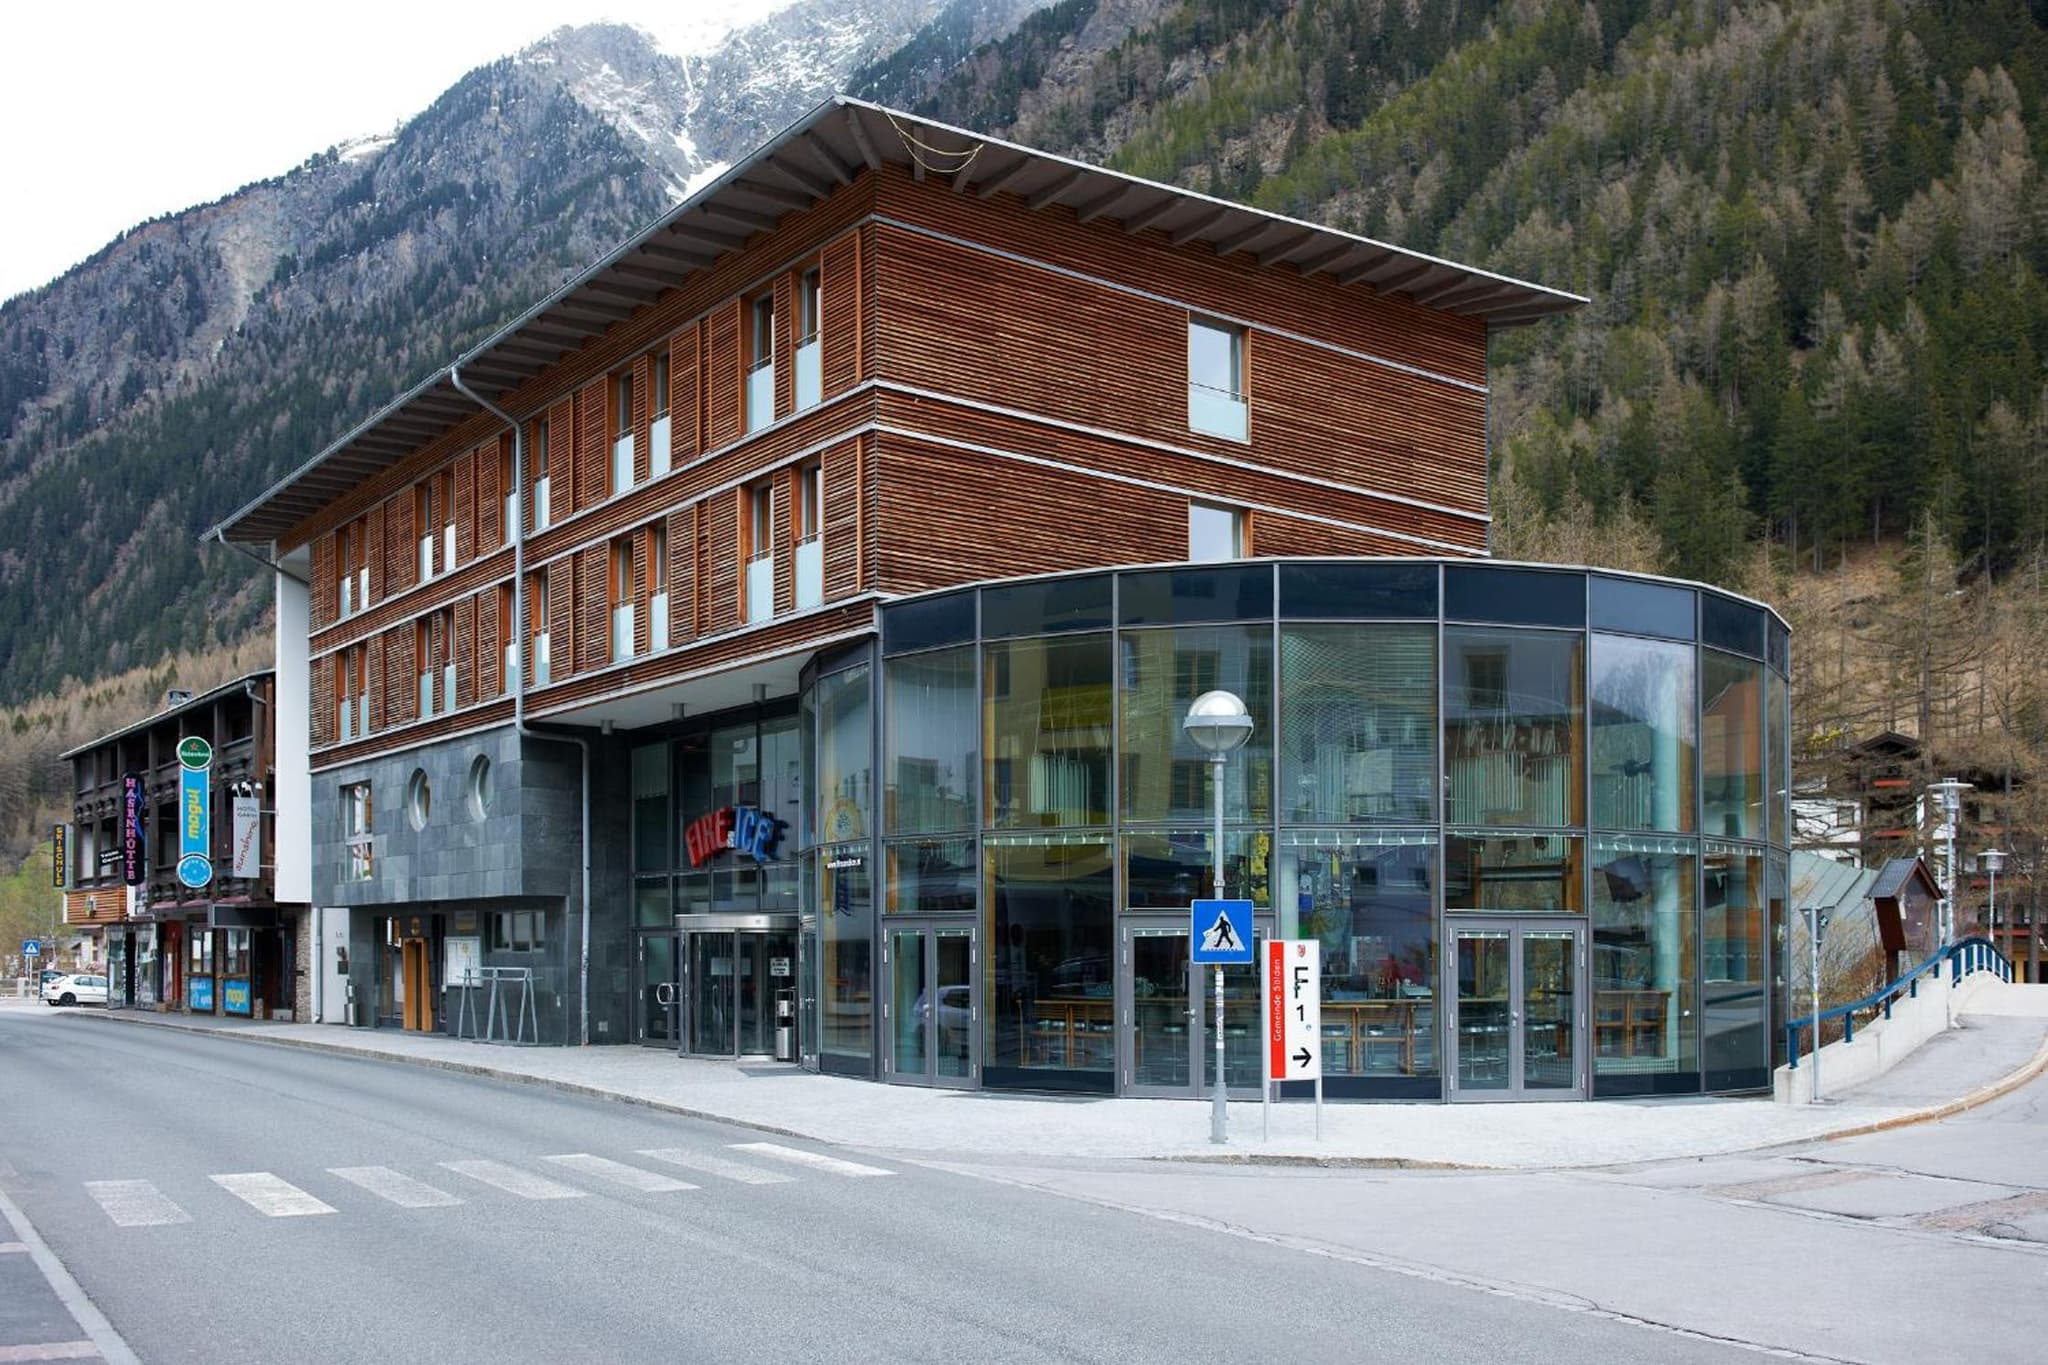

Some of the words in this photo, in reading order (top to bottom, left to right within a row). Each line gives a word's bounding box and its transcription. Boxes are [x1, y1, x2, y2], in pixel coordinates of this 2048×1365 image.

[186, 788, 203, 839] mogul
[685, 806, 732, 868] FIRE
[735, 806, 775, 864] ICE
[55, 827, 64, 886] SKISCHULE
[1294, 966, 1309, 999] F
[1273, 994, 1282, 1042] Gemeinde
[1296, 1004, 1304, 1021] 1
